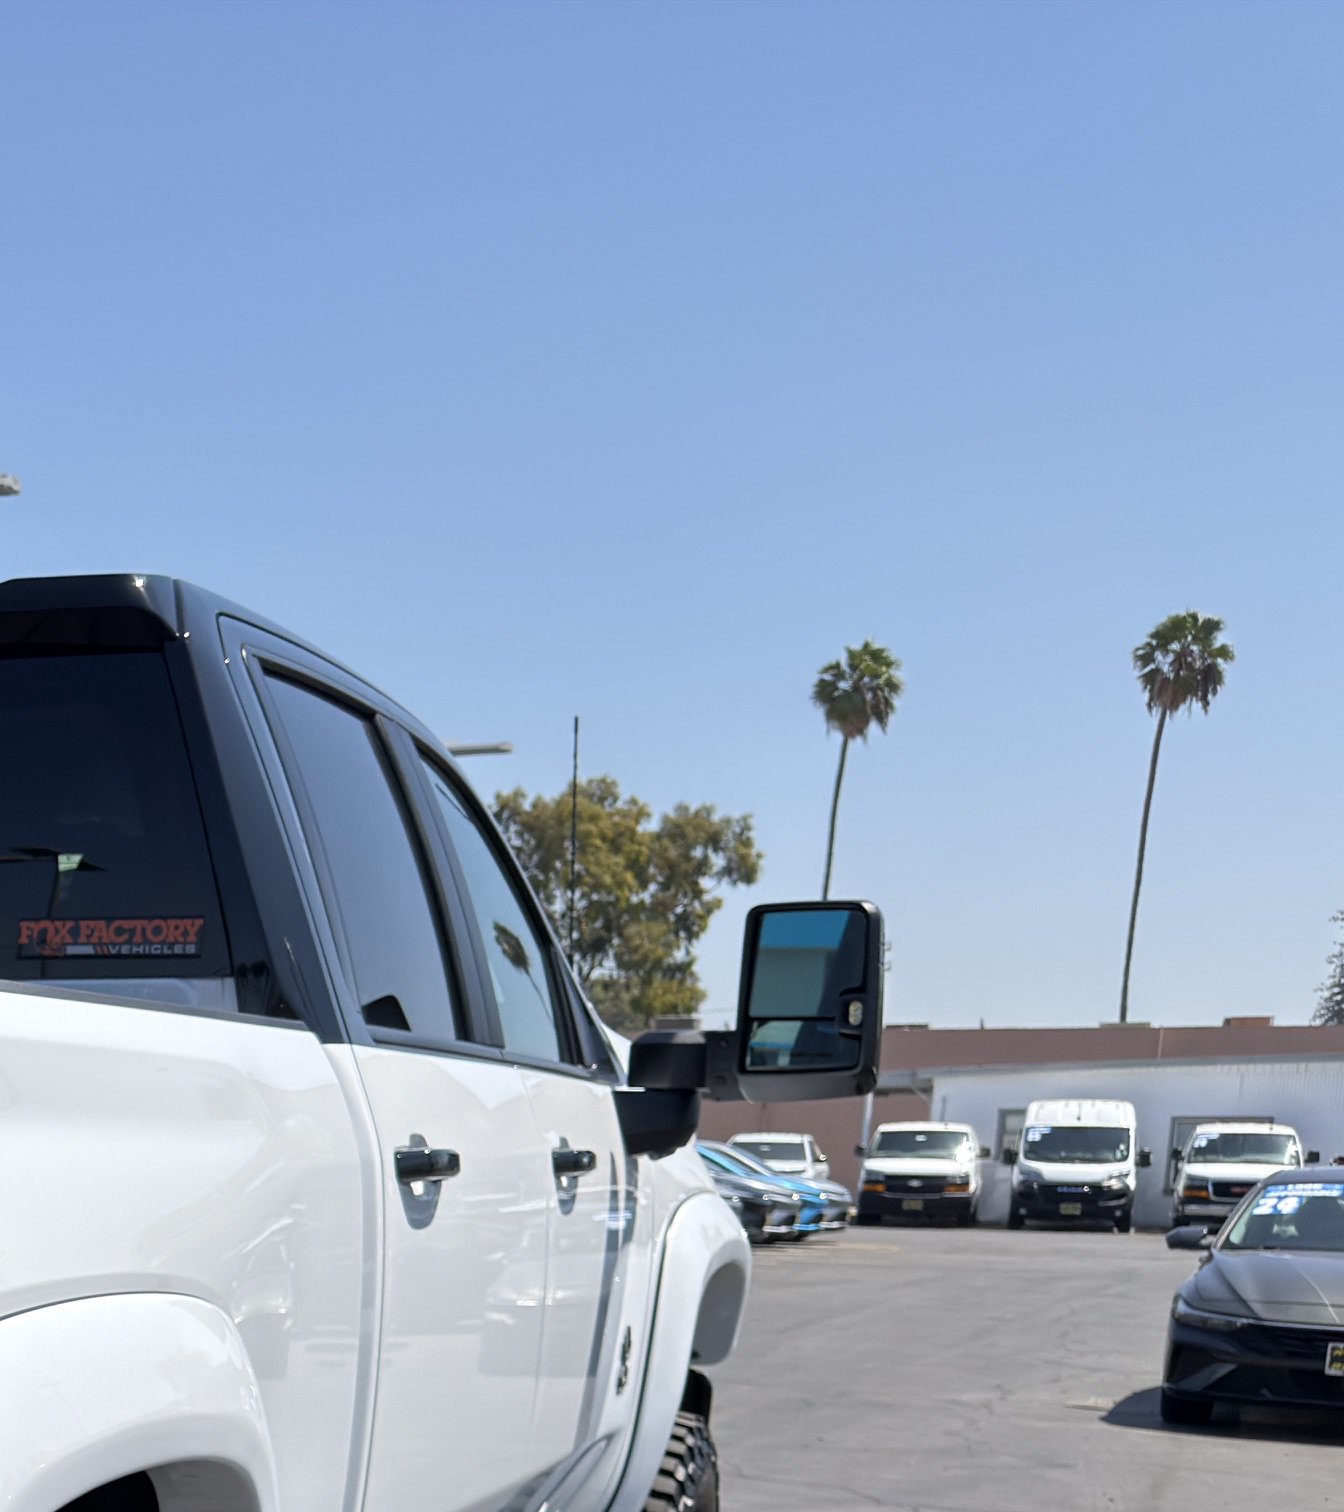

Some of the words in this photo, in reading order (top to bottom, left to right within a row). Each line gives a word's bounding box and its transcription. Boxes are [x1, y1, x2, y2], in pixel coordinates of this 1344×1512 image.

[18, 919, 76, 950] FOX
[77, 918, 204, 944] FACTORY
[108, 944, 196, 955] VEHICLES
